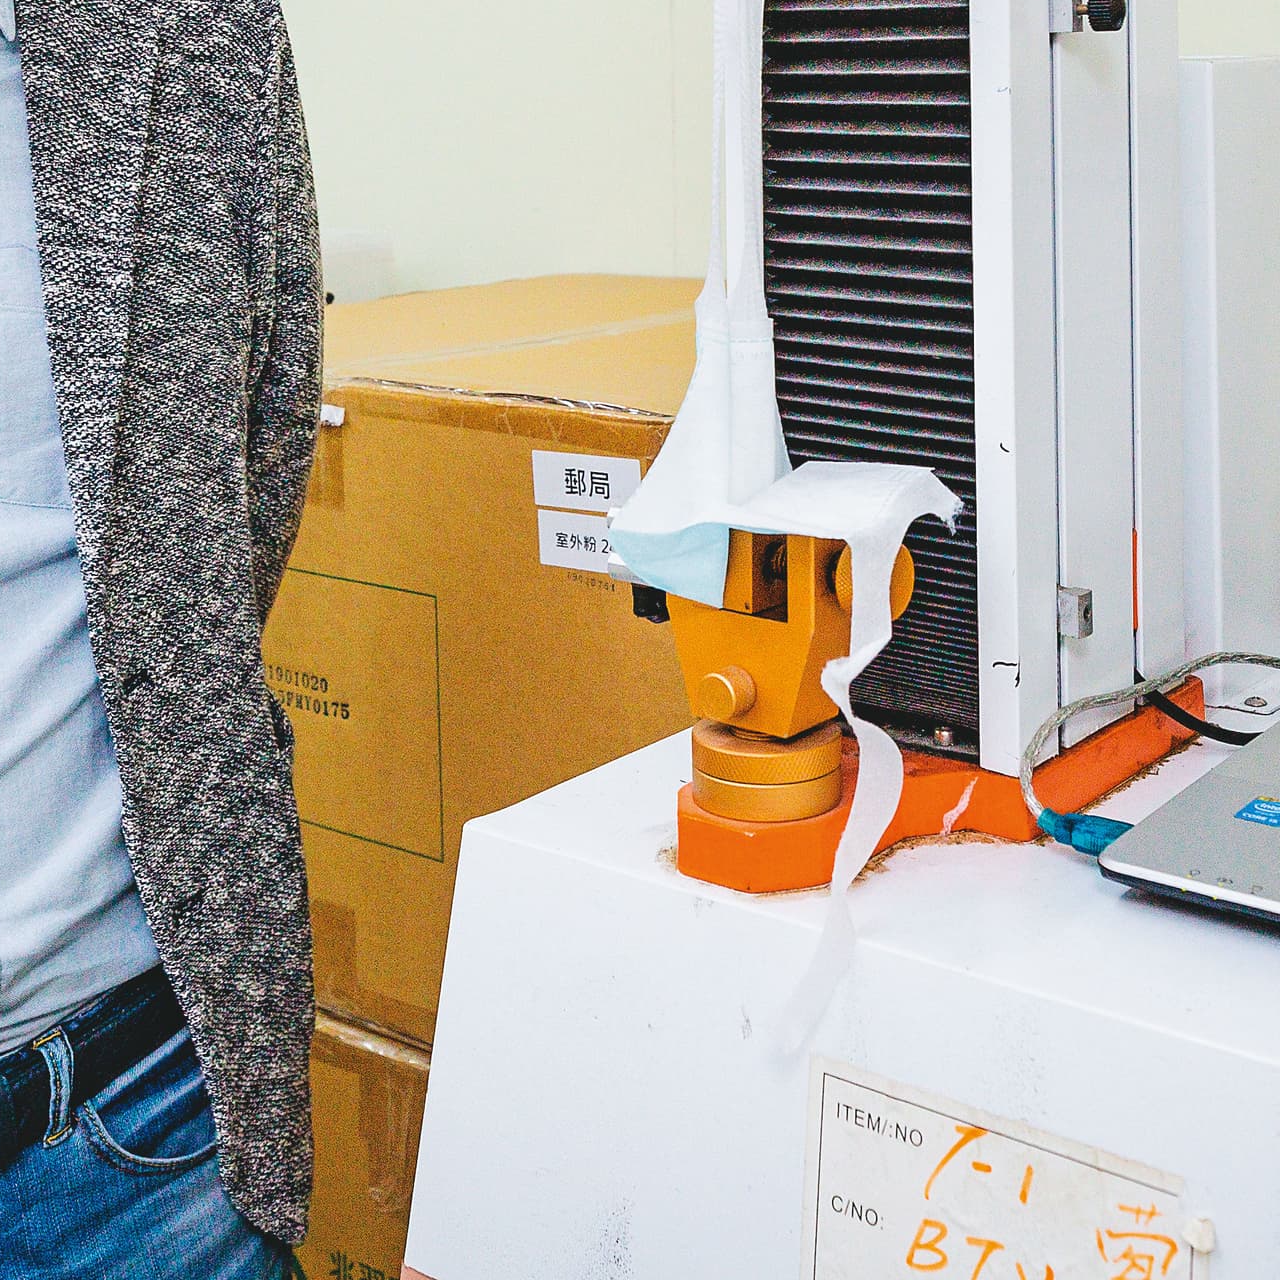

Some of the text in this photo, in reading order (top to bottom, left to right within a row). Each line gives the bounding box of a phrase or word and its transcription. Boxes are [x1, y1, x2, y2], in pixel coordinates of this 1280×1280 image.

[564, 468, 610, 499] 郵局
[555, 532, 613, 554] 室外粉 2
[831, 1195, 885, 1229] C/NO:
